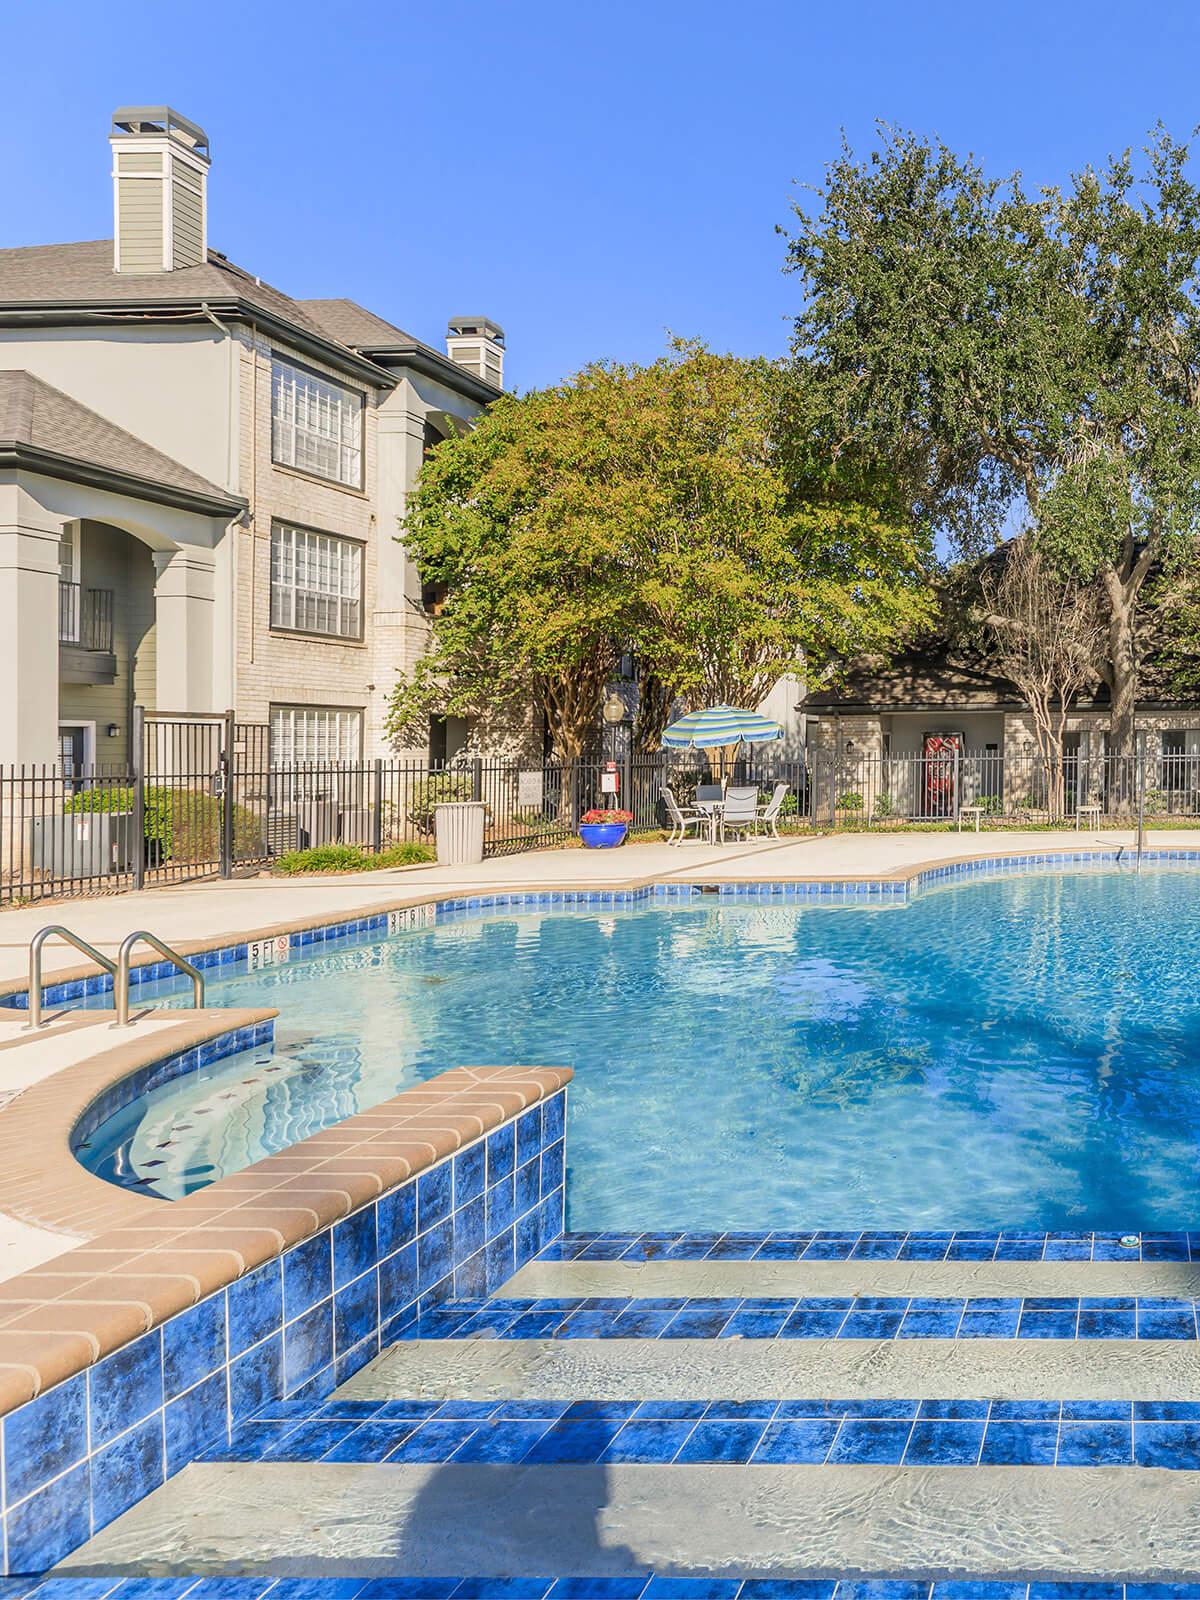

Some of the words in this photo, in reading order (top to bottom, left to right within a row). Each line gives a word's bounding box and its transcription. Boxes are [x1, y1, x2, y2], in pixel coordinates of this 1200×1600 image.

[410, 909, 416, 921] 6
[252, 943, 259, 957] 5
[263, 940, 275, 955] FT
